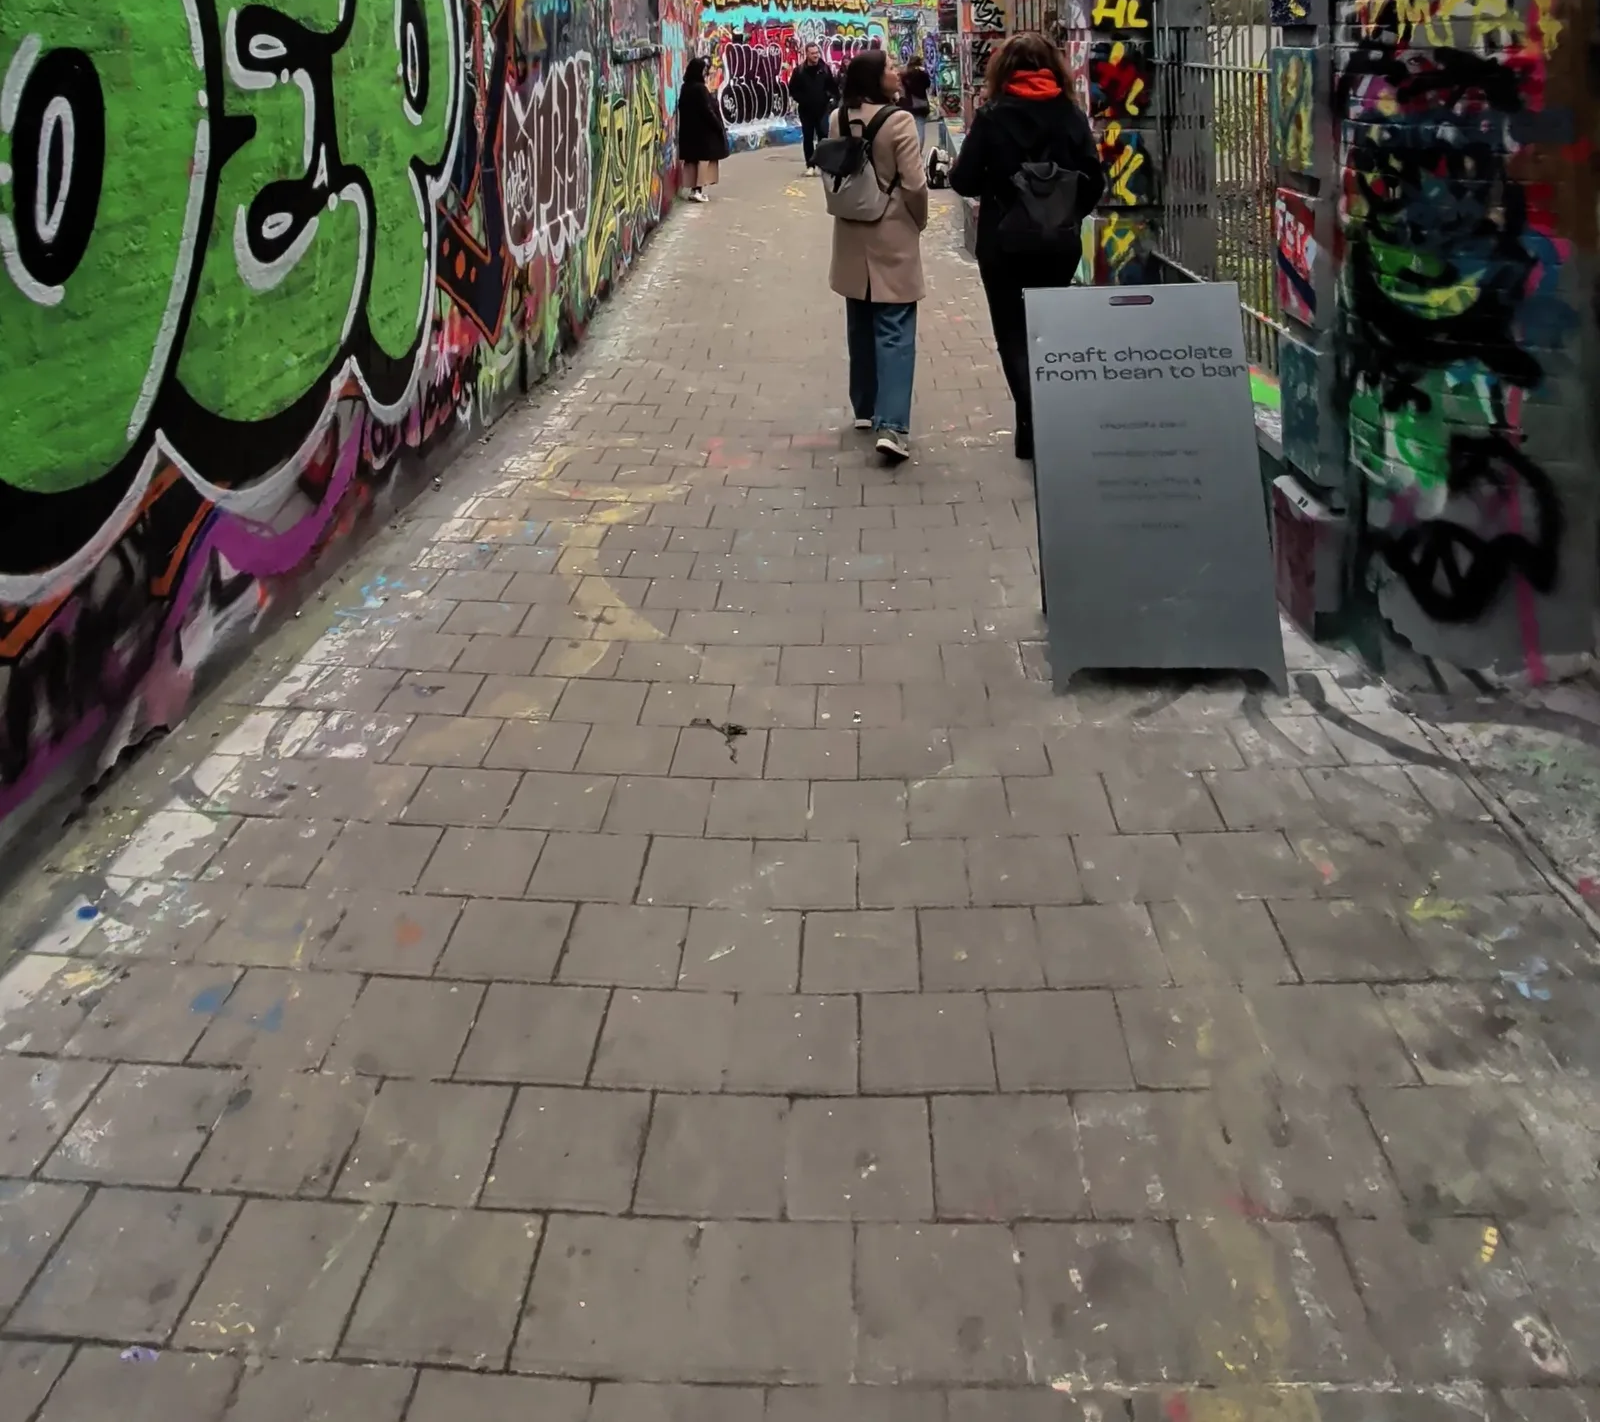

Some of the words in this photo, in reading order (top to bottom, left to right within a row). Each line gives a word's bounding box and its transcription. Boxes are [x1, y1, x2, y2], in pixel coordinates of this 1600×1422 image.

[1043, 346, 1107, 364] craft
[1113, 344, 1233, 363] chocolate
[1034, 366, 1097, 382] from
[1103, 364, 1163, 380] bean
[1169, 365, 1196, 379] to
[1202, 362, 1246, 378] bar
